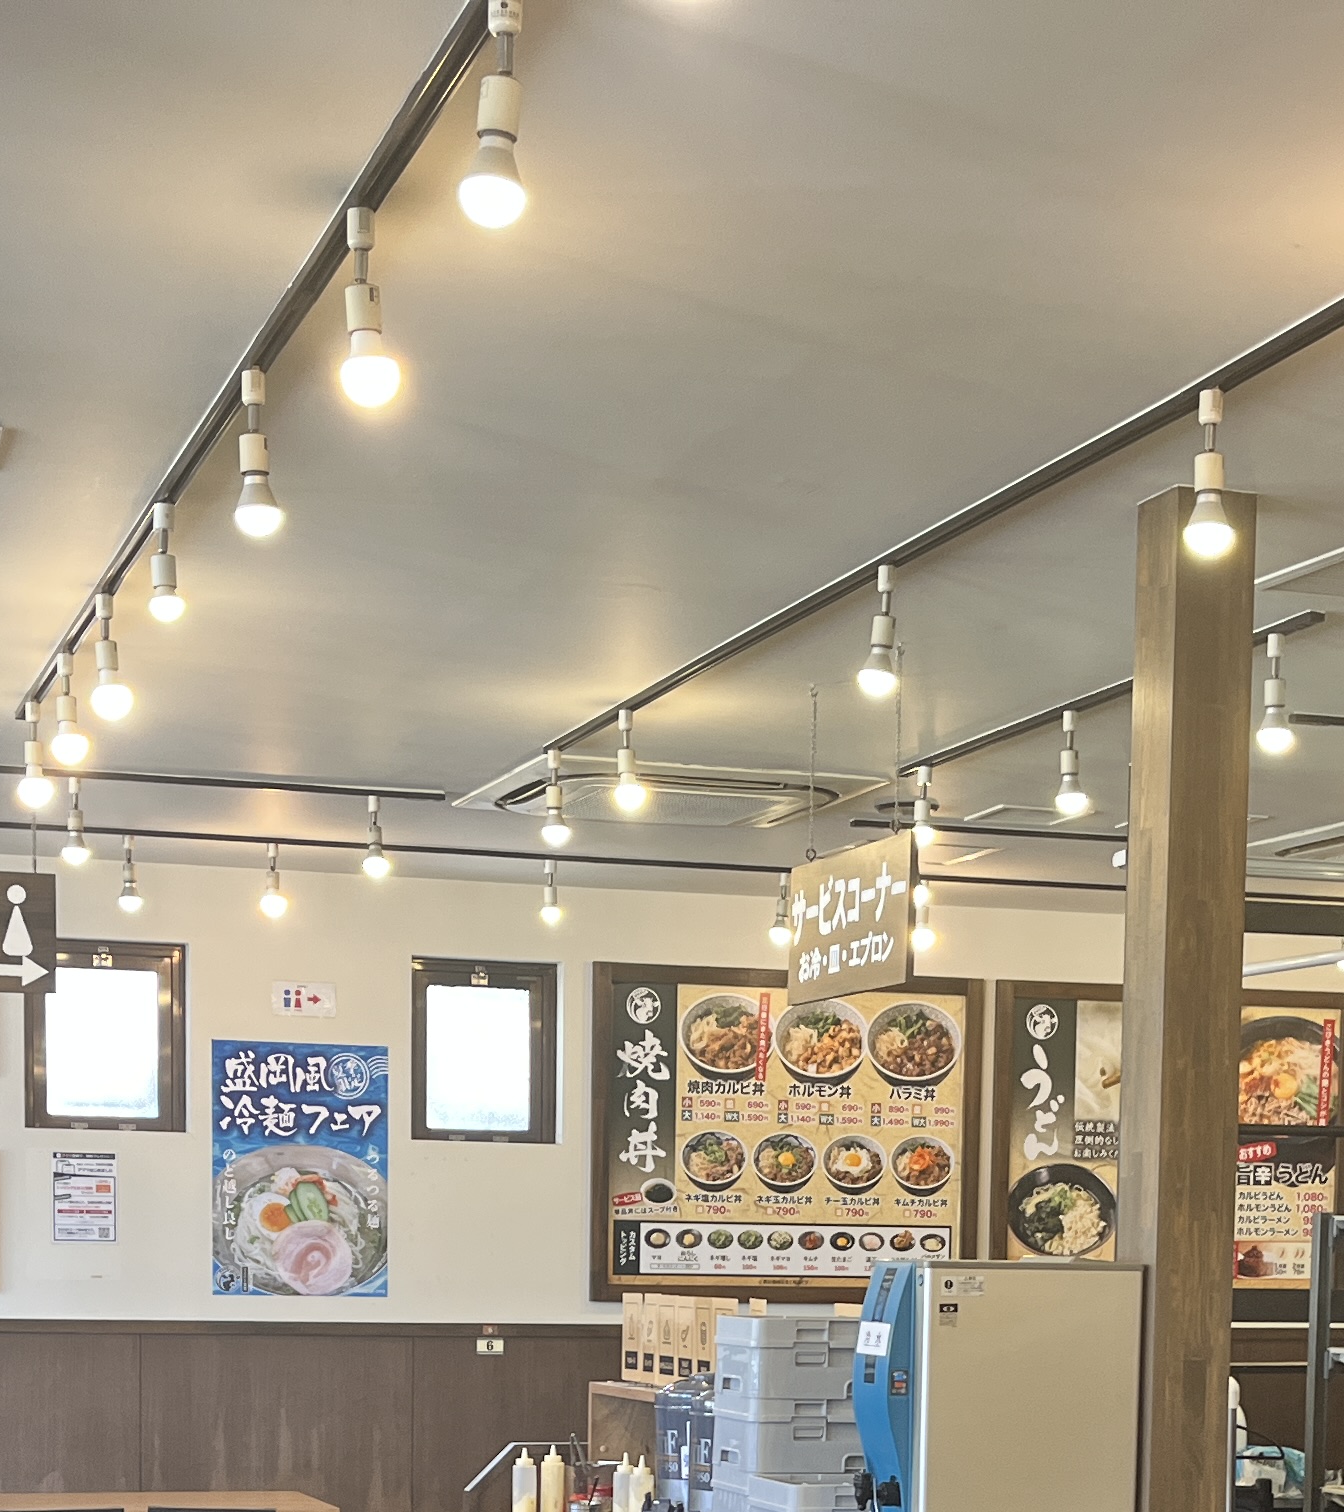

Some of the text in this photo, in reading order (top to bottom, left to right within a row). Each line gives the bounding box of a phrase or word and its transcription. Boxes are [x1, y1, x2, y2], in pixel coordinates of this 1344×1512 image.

[792, 862, 906, 946] サービスコーナー
[798, 931, 894, 983] お冷・皿・エプロン
[220, 1050, 334, 1094] 盛岡風
[687, 1080, 765, 1096] 焼肉カルビ丼
[788, 1084, 852, 1098] ホルモン丼
[889, 1088, 936, 1101] ハラミ丼
[617, 1029, 671, 1173] 焼肉丼
[1020, 1045, 1065, 1161] うどん
[219, 1095, 382, 1136] 冷麺フェア
[683, 1110, 692, 1121] 大
[778, 1113, 788, 1123] 大
[871, 1116, 881, 1126] 大
[1239, 1144, 1272, 1160] おすすめ
[1236, 1162, 1329, 1186] 旨辛うどん
[222, 1149, 236, 1241] のど越し良し
[685, 1193, 742, 1204] ネギ塩カルビ丼
[756, 1194, 813, 1206] ネギ玉カルビ丼
[825, 1196, 880, 1206] チー玉カルビ丼
[1238, 1192, 1284, 1201] カルビうどん
[894, 1198, 948, 1208] キムチカルビ丼
[1237, 1203, 1292, 1213] ホルモンうどん
[1238, 1215, 1290, 1225] カルビラーメン
[1237, 1227, 1298, 1237] ホルモンラーメン
[619, 1231, 627, 1266] トッピング
[486, 1340, 494, 1352] 6
